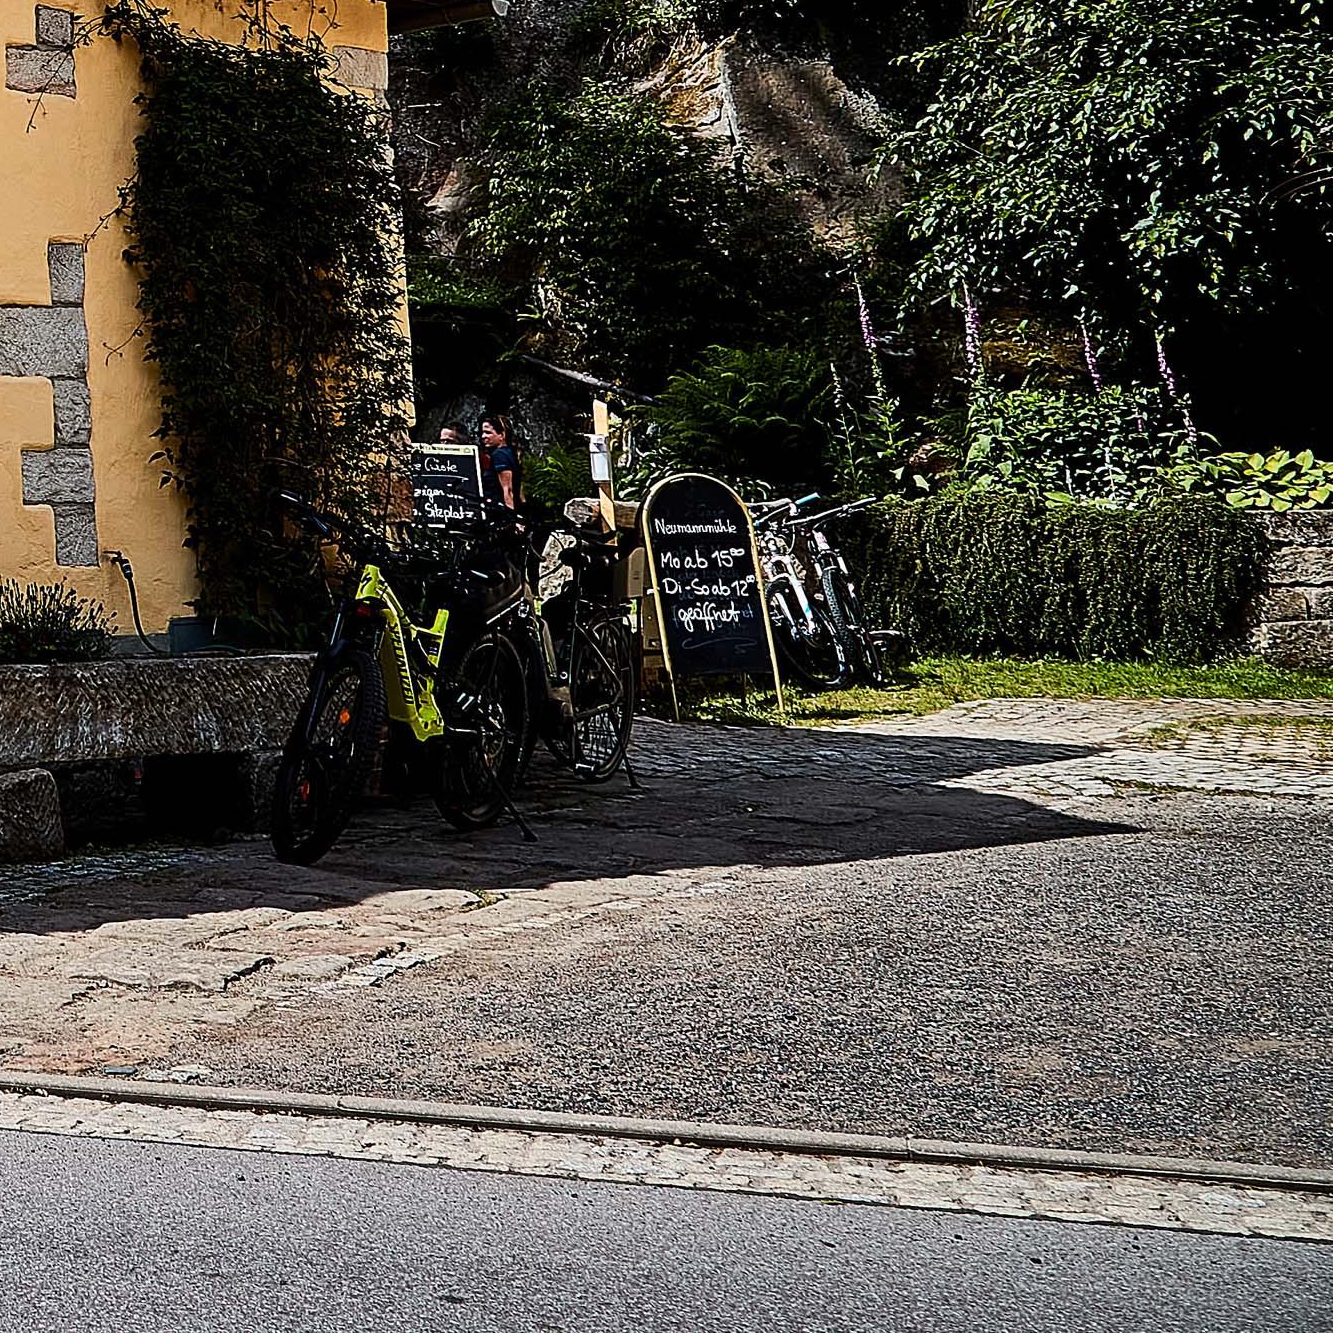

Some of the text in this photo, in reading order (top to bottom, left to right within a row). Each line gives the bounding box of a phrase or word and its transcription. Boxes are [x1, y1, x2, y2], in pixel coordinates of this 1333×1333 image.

[654, 518, 737, 534] Neumannmühle
[660, 551, 681, 568] Mo
[684, 548, 708, 568] ab
[711, 578, 731, 596] ab
[678, 601, 740, 633] geöffnet
